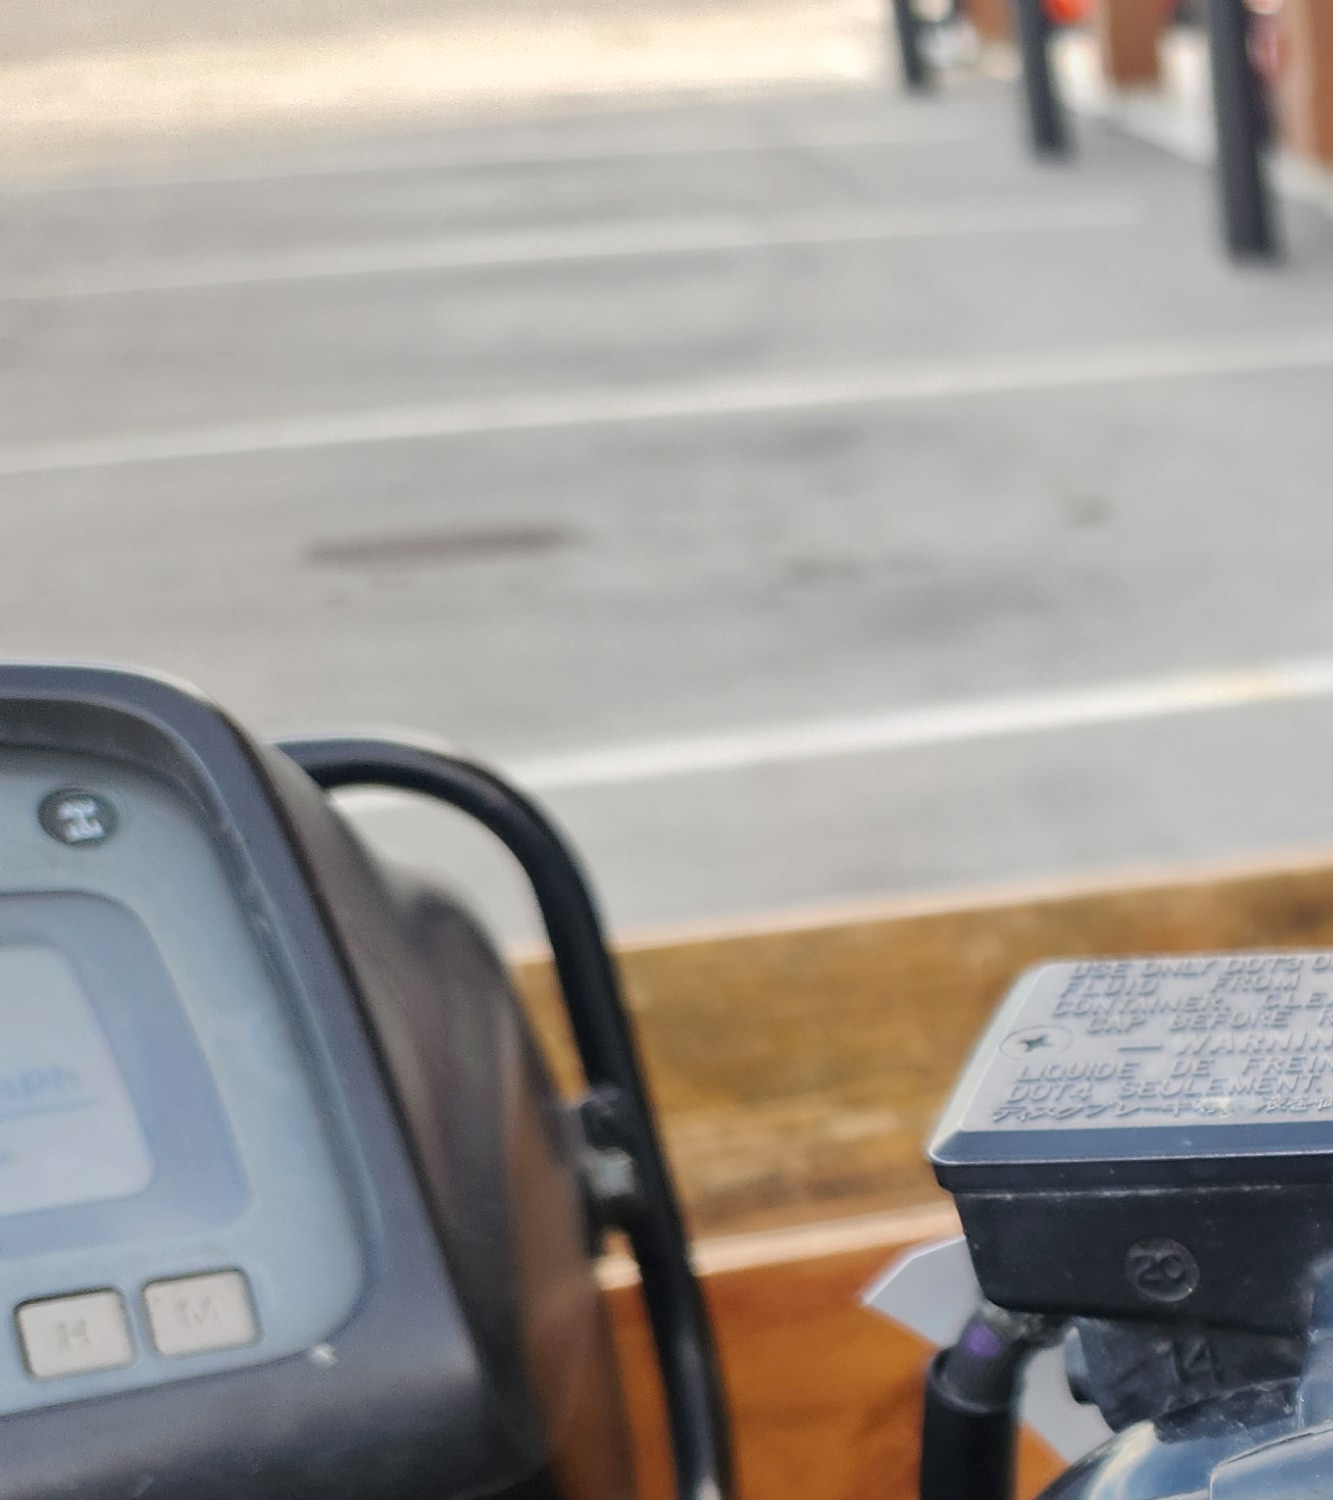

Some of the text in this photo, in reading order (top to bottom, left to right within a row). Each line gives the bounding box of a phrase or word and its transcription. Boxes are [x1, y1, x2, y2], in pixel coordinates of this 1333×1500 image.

[1070, 962, 1132, 979] USE
[1142, 959, 1218, 979] ONLY
[1225, 956, 1304, 976] DOT3
[1060, 976, 1161, 998] FLUID
[1209, 973, 1299, 994] FROM
[1086, 1014, 1148, 1036] CAP
[1168, 1009, 1292, 1033] BEFORE
[1016, 1062, 1142, 1084] LIQUIDE
[1168, 1059, 1215, 1079] DE
[1006, 1075, 1323, 1104] DOT4 SEULEMENT.
